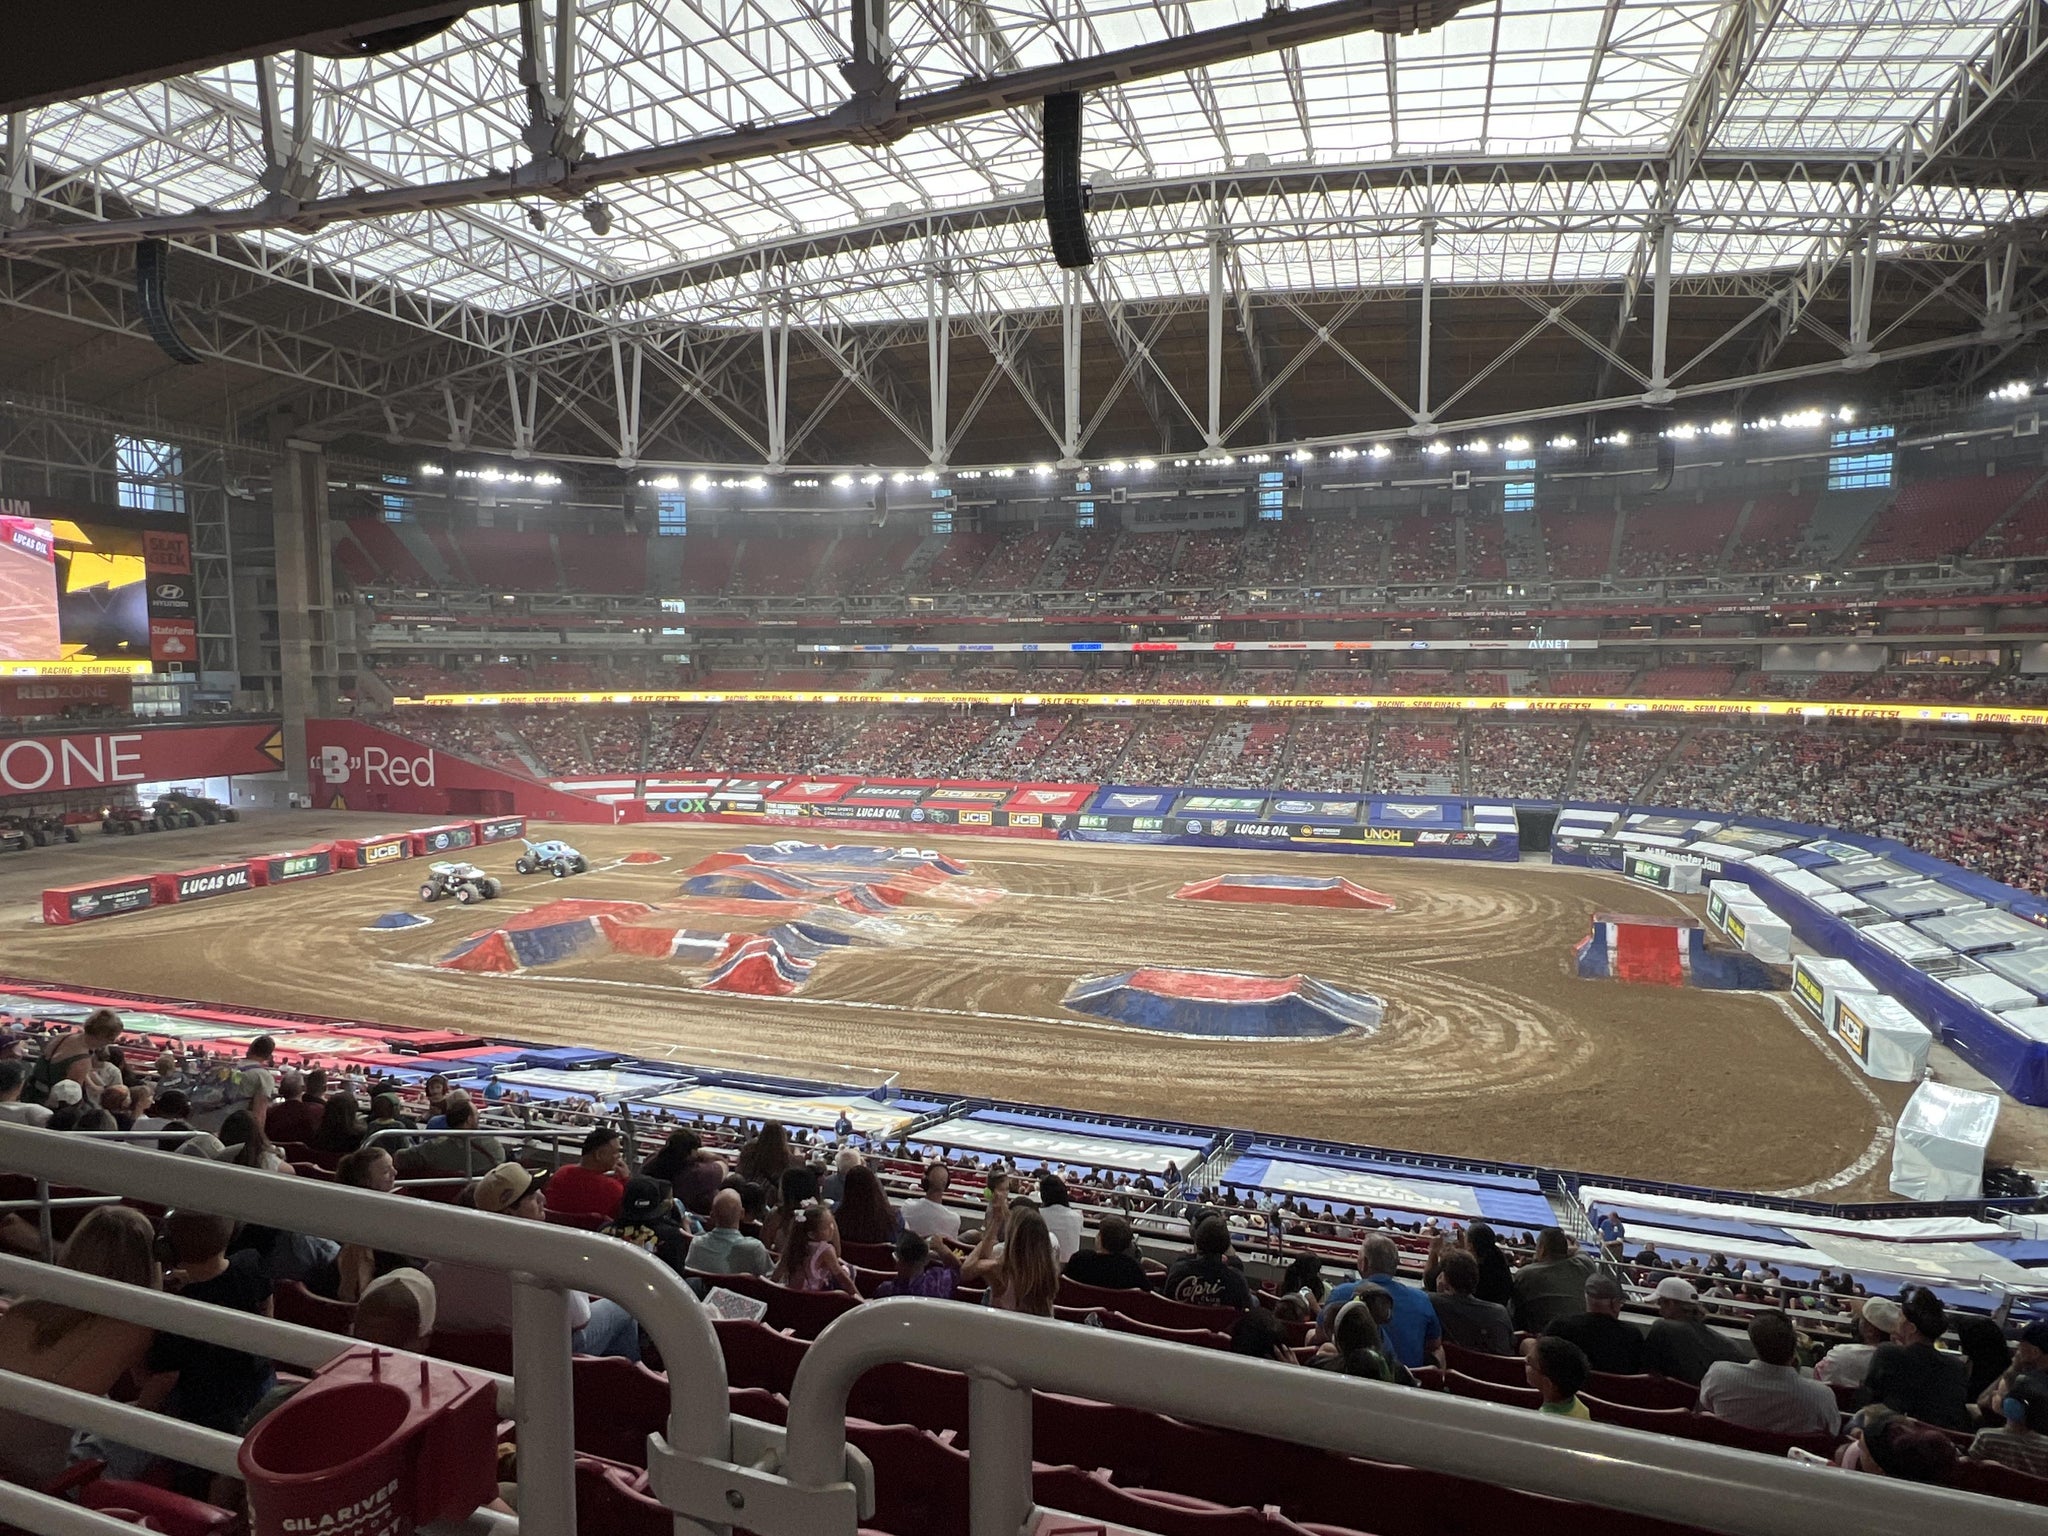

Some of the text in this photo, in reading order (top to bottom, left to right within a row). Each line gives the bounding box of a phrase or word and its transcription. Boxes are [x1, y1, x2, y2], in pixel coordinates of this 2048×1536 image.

[13, 532, 36, 549] LUCAS
[1528, 639, 1570, 649] AVNET
[41, 667, 73, 675] RACING
[104, 666, 131, 674] FINALS
[364, 746, 435, 787] Red
[664, 799, 706, 813] COX
[856, 808, 901, 818] LUCAS OIL
[961, 812, 989, 822] JCB
[1012, 814, 1040, 824] JCB
[1079, 815, 1108, 826] BKT
[1133, 817, 1162, 829] BKT
[1234, 823, 1290, 836] LUCAS OIL
[1364, 828, 1401, 840] UNOH
[370, 845, 399, 860] JCB
[283, 858, 317, 874] BKT
[1635, 860, 1661, 878] BKT
[181, 871, 248, 895] LUCAS OIL
[1175, 1276, 1226, 1303] Capri
[282, 1513, 335, 1532] GILA
[338, 1478, 399, 1522] RIVER
